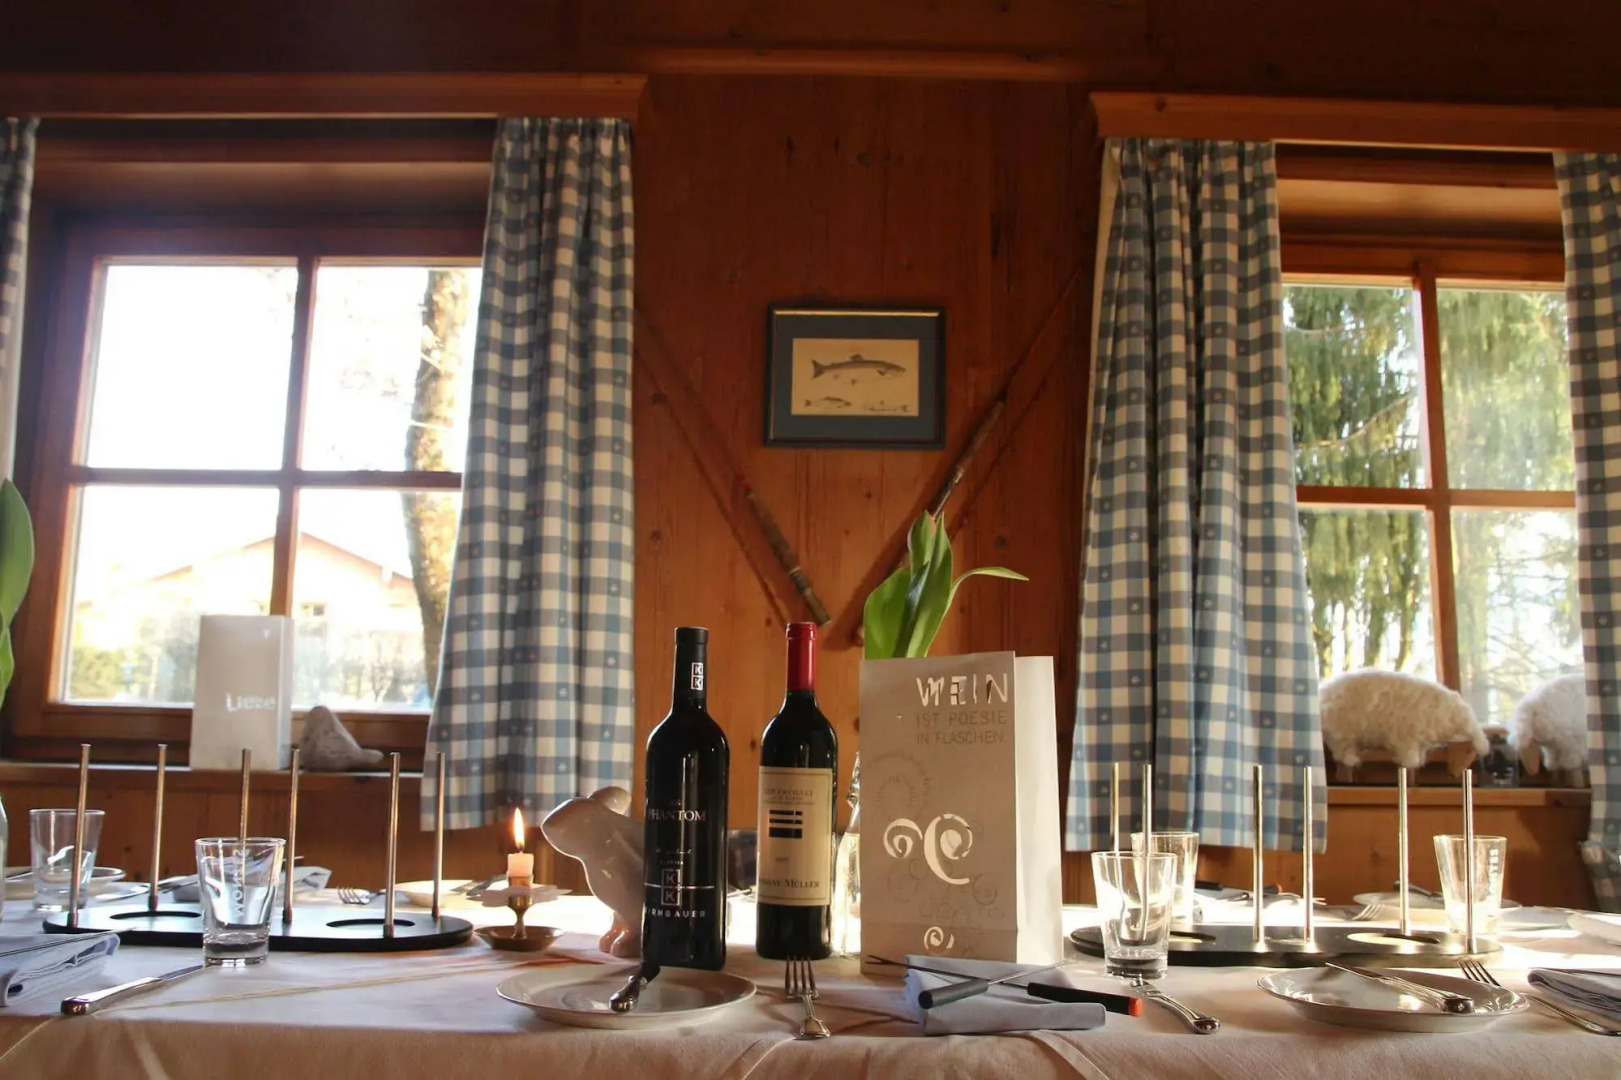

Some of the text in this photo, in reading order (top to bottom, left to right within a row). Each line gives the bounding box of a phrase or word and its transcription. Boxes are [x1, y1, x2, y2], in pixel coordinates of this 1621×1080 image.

[915, 672, 1008, 707] WEIN
[915, 709, 1008, 728] IST POESIE
[915, 728, 1004, 746] IN FLASCHEN
[1488, 848, 1499, 896] ONTES
[647, 907, 706, 918] IRNBAUER
